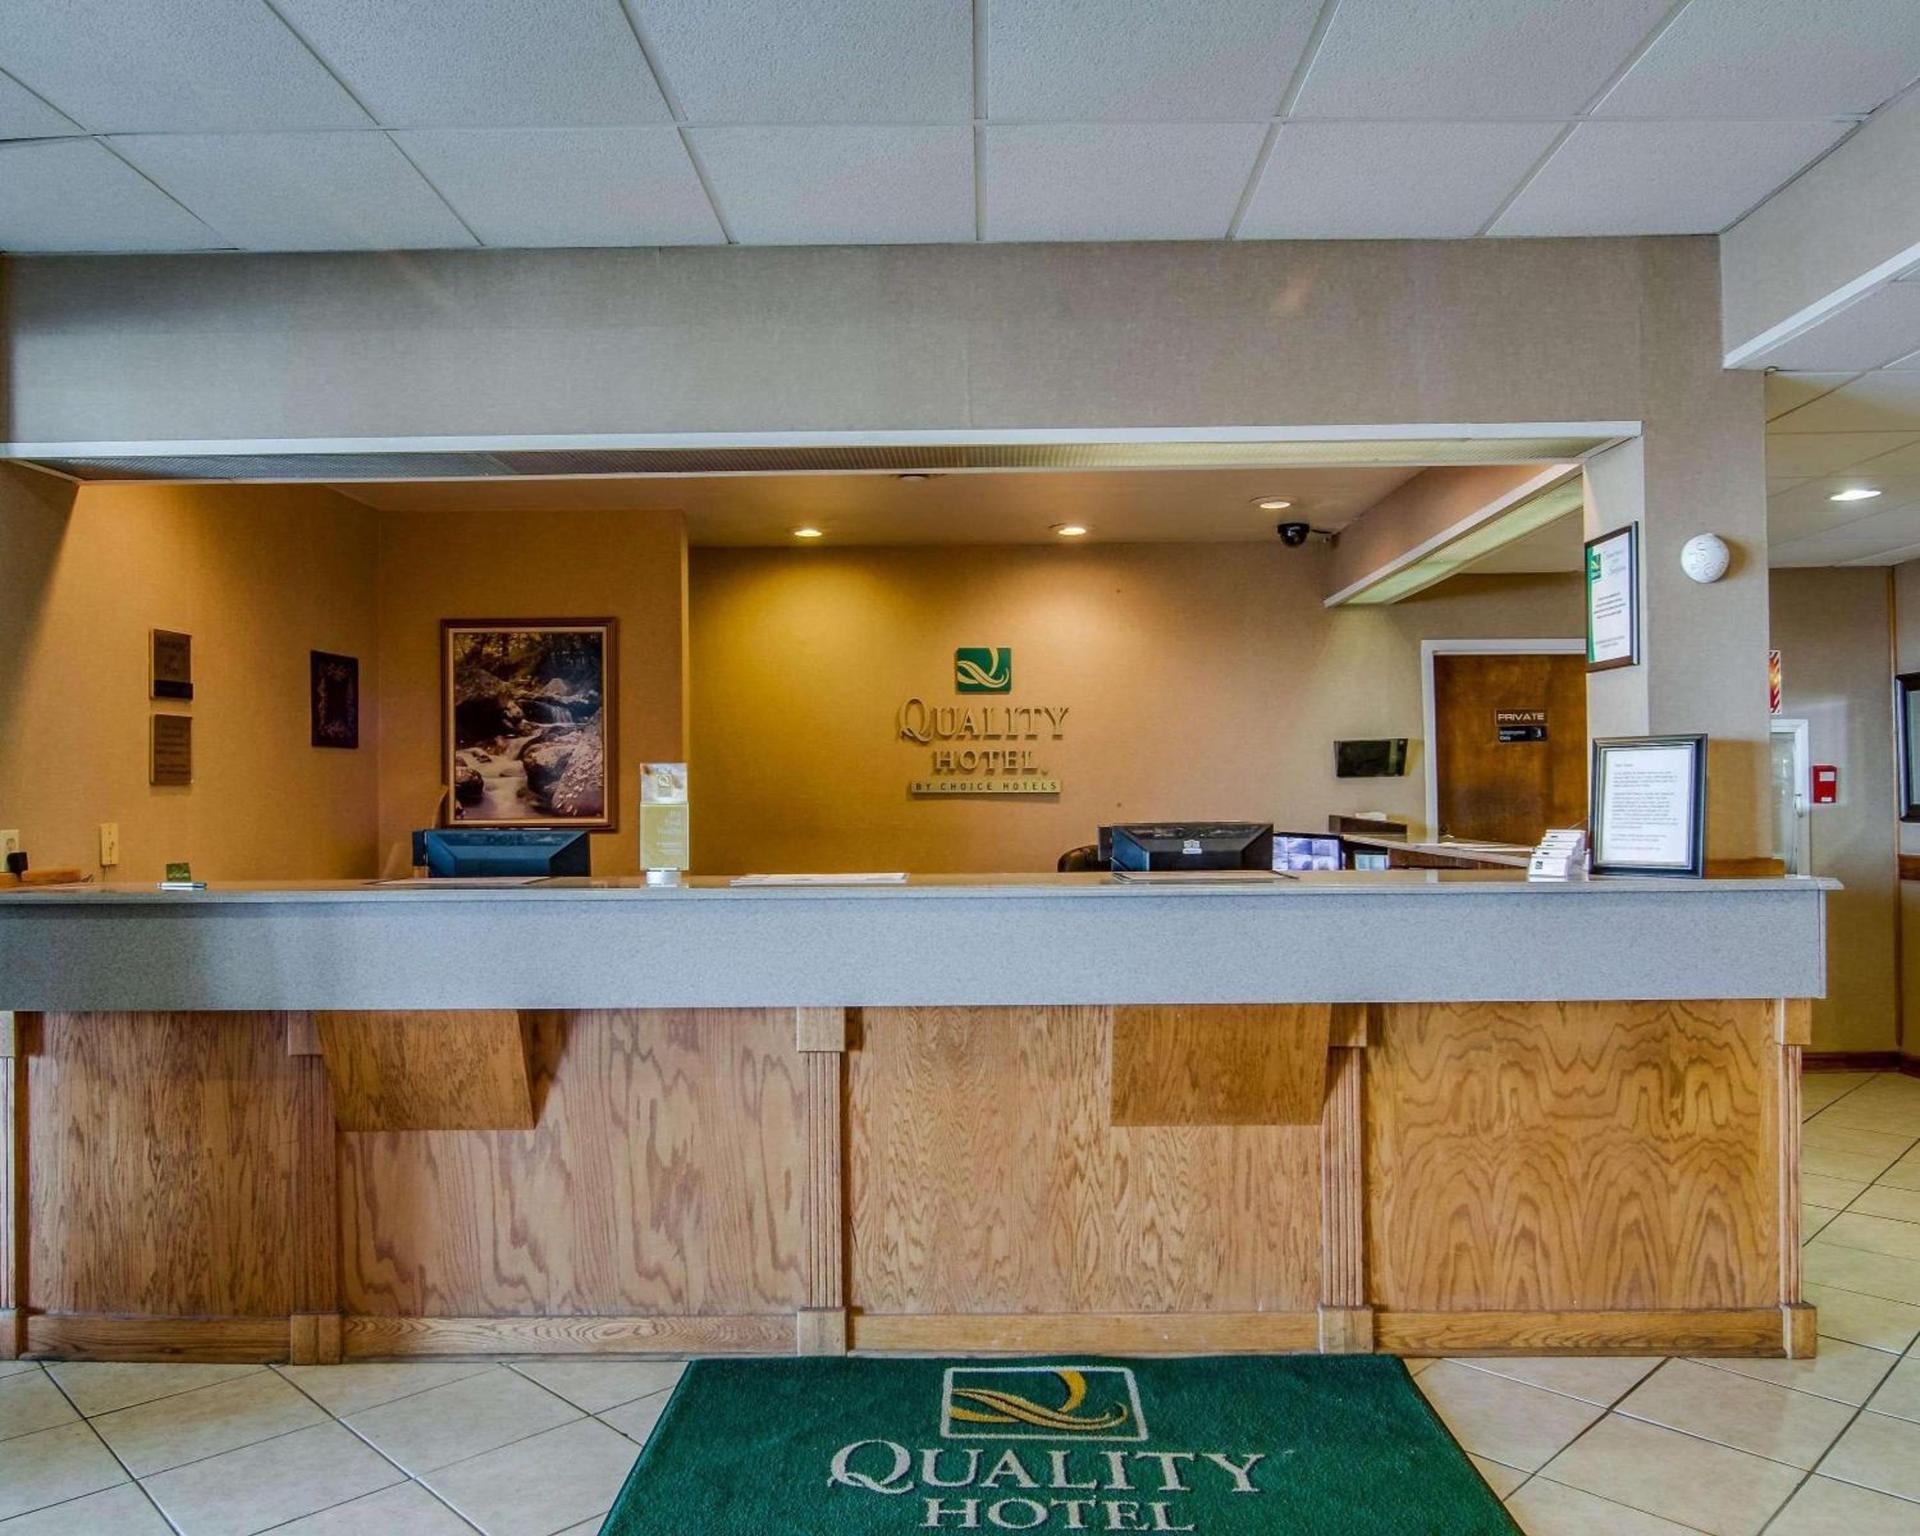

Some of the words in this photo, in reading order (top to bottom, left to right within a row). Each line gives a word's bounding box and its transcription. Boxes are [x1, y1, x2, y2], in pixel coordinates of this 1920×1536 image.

[898, 698, 1069, 743] QUALITY
[1497, 712, 1545, 721] PRIVATE
[934, 750, 1039, 774] HOTEL
[915, 782, 931, 791] BY
[940, 782, 993, 791] CHOICE
[1002, 781, 1058, 791] HOTELS
[827, 1439, 1266, 1495] QUALITY
[920, 1497, 1196, 1531] HOTEL
